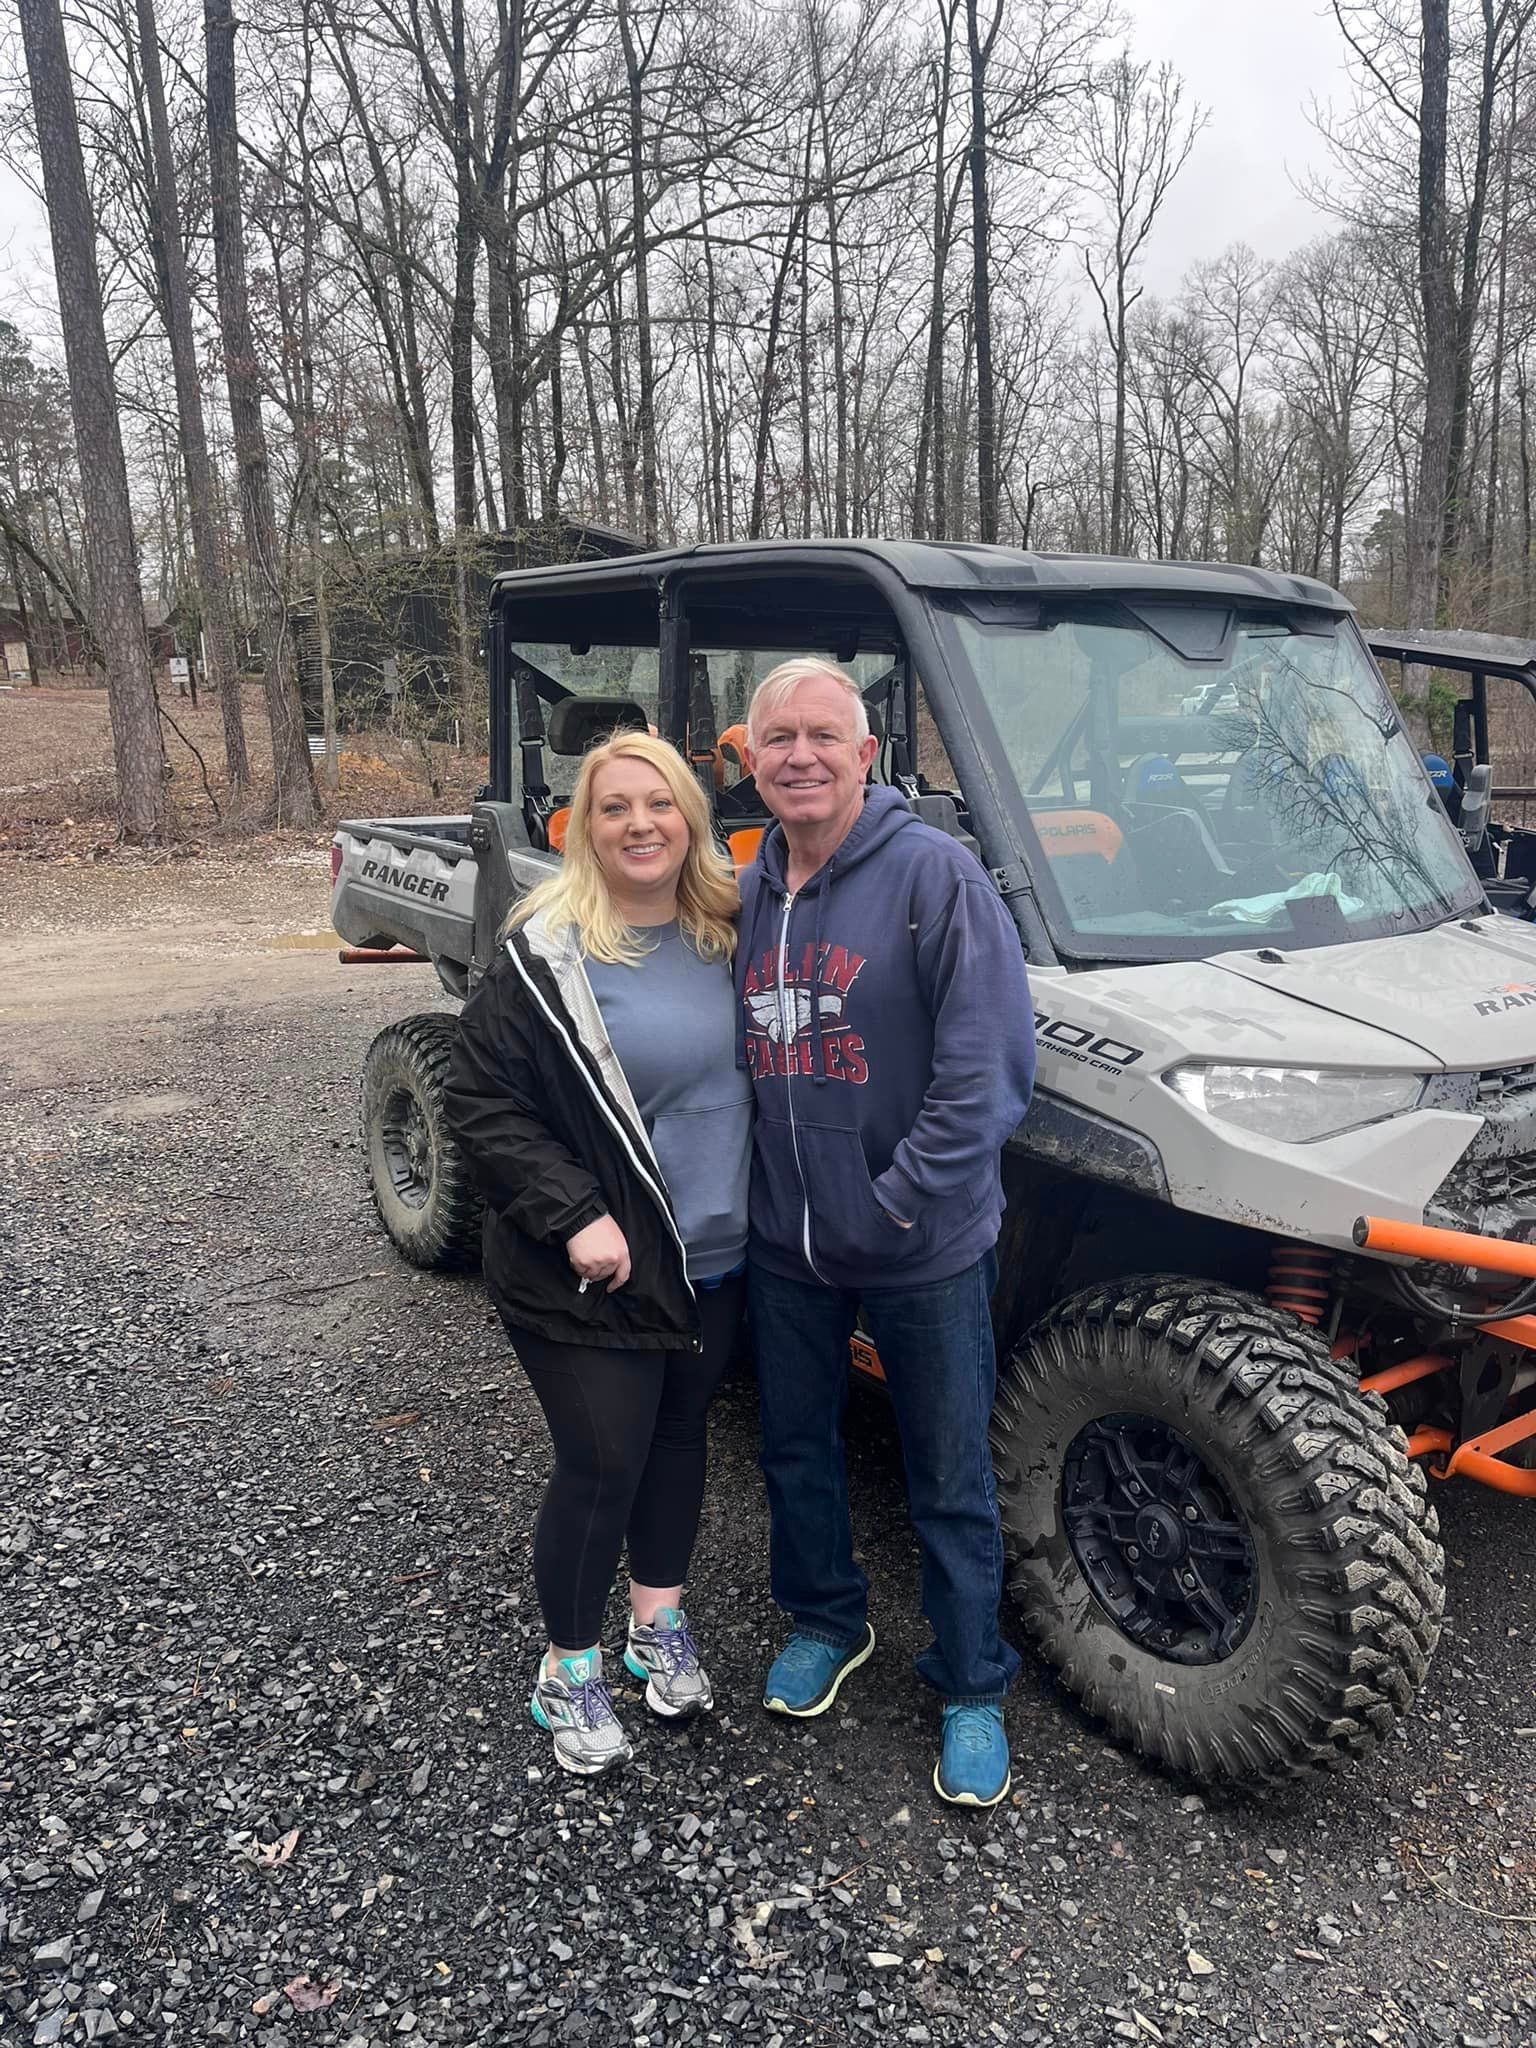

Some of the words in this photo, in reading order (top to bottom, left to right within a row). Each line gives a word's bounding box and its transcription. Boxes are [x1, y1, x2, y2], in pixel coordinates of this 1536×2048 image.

[1039, 824, 1096, 838] POLARIS
[361, 859, 450, 902] RANGER
[1089, 1059, 1122, 1076] CAM
